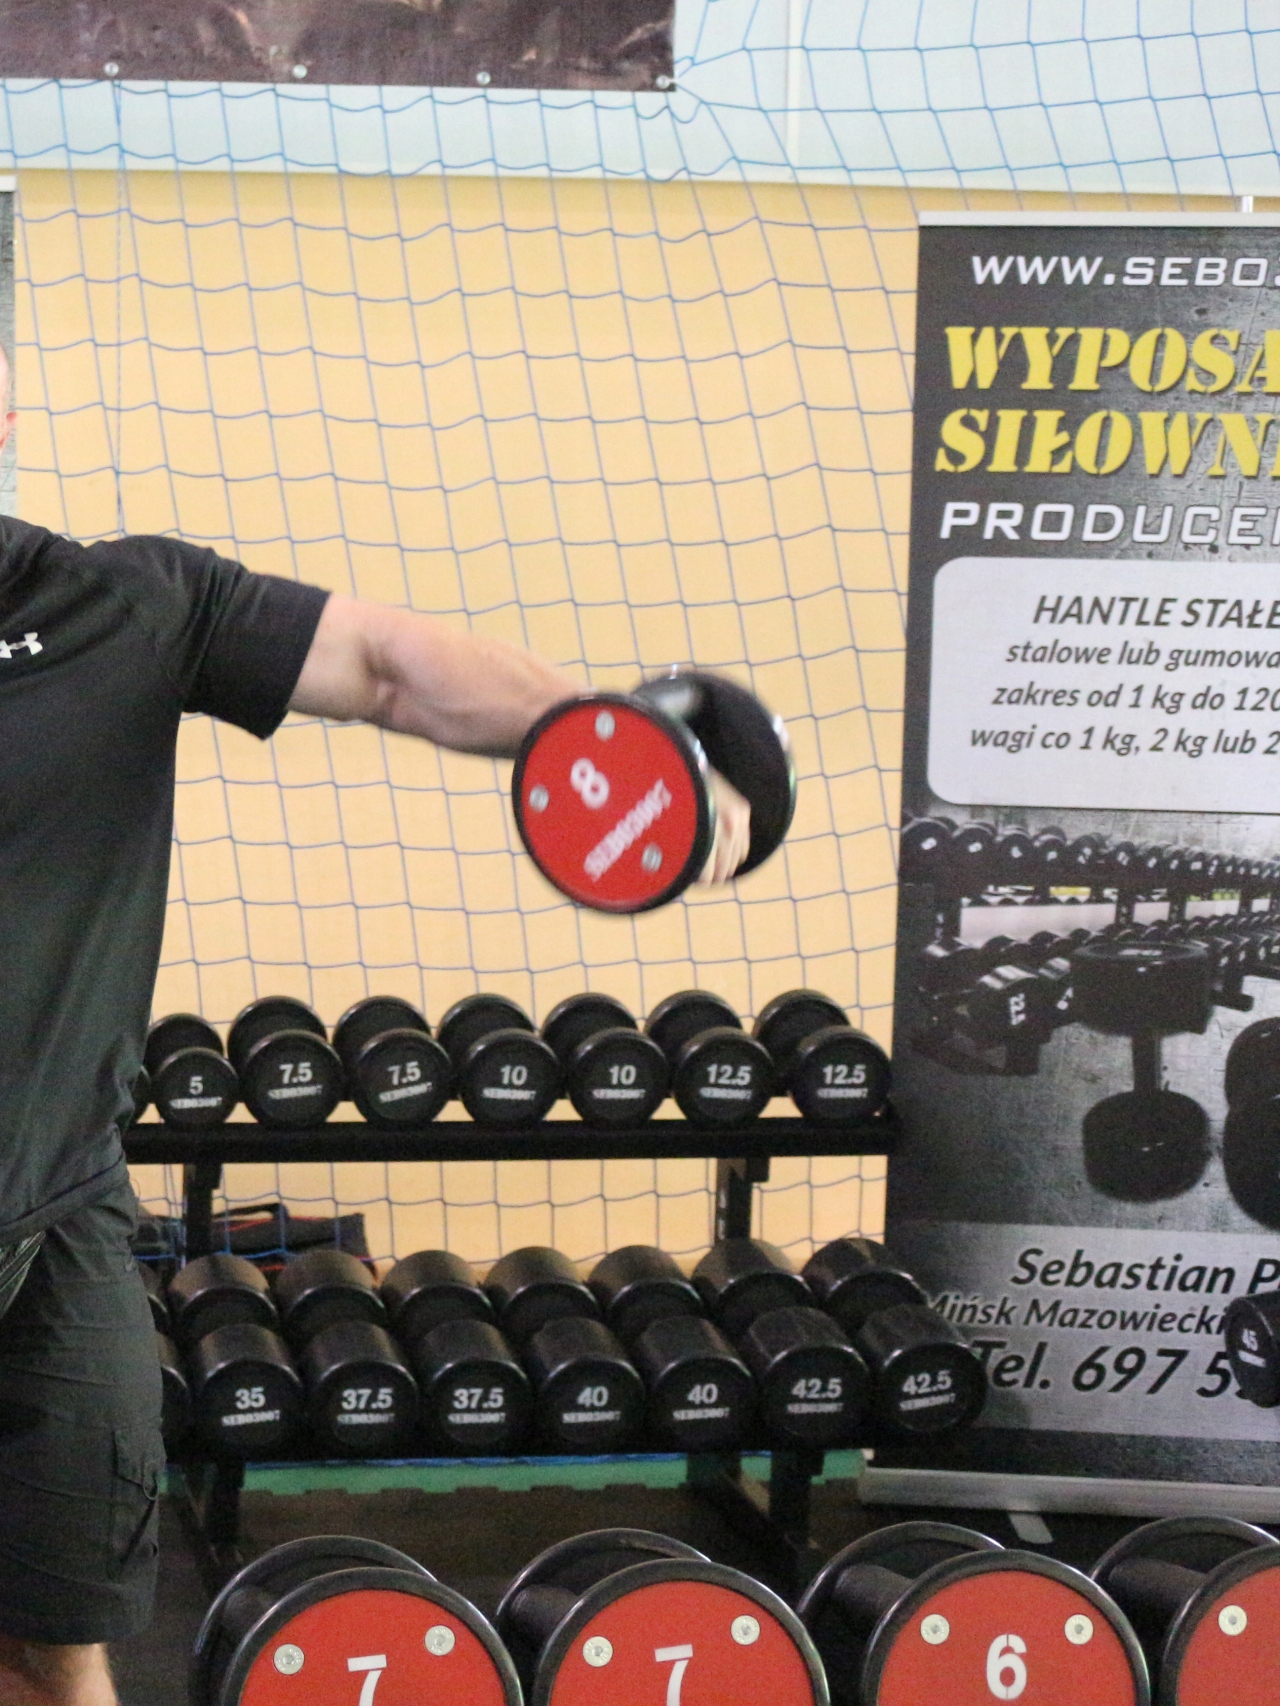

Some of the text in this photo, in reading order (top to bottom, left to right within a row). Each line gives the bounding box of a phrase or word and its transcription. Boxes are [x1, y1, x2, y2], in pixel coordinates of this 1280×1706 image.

[972, 255, 1280, 287] WWW.SEBO
[935, 408, 1280, 477] SIŁOWN
[940, 502, 1280, 546] PRODUCE
[1033, 595, 1177, 627] HANTLE
[1006, 639, 1111, 665] stalowe
[1118, 641, 1160, 666] lub
[992, 682, 1080, 707] zakres
[1086, 684, 1123, 708] od
[1129, 685, 1144, 709] 1
[1151, 685, 1185, 714] kg
[1191, 686, 1225, 711] do
[971, 725, 1037, 753] wagi
[1041, 729, 1071, 750] co
[1080, 726, 1094, 750] 1
[1149, 728, 1168, 752] 2
[1174, 729, 1208, 758] kg
[1213, 729, 1256, 754] lub
[571, 758, 610, 810] 8
[279, 1061, 313, 1085] 7.5
[387, 1061, 421, 1086] 7.5
[500, 1066, 528, 1086] 10
[609, 1065, 637, 1086] 10
[706, 1064, 751, 1086] 12.5
[822, 1064, 866, 1085] 12.5
[189, 1076, 204, 1096] 5
[1011, 1248, 1235, 1295] Sebastian
[1071, 1345, 1189, 1395] 697
[687, 1383, 718, 1405] 40
[792, 1378, 843, 1399] 42.5
[902, 1370, 952, 1396] 42.5
[235, 1387, 266, 1410] 35
[341, 1387, 394, 1411] 37.5
[453, 1387, 505, 1410] 37.5
[576, 1386, 609, 1408] 40
[986, 1634, 1027, 1700] 6
